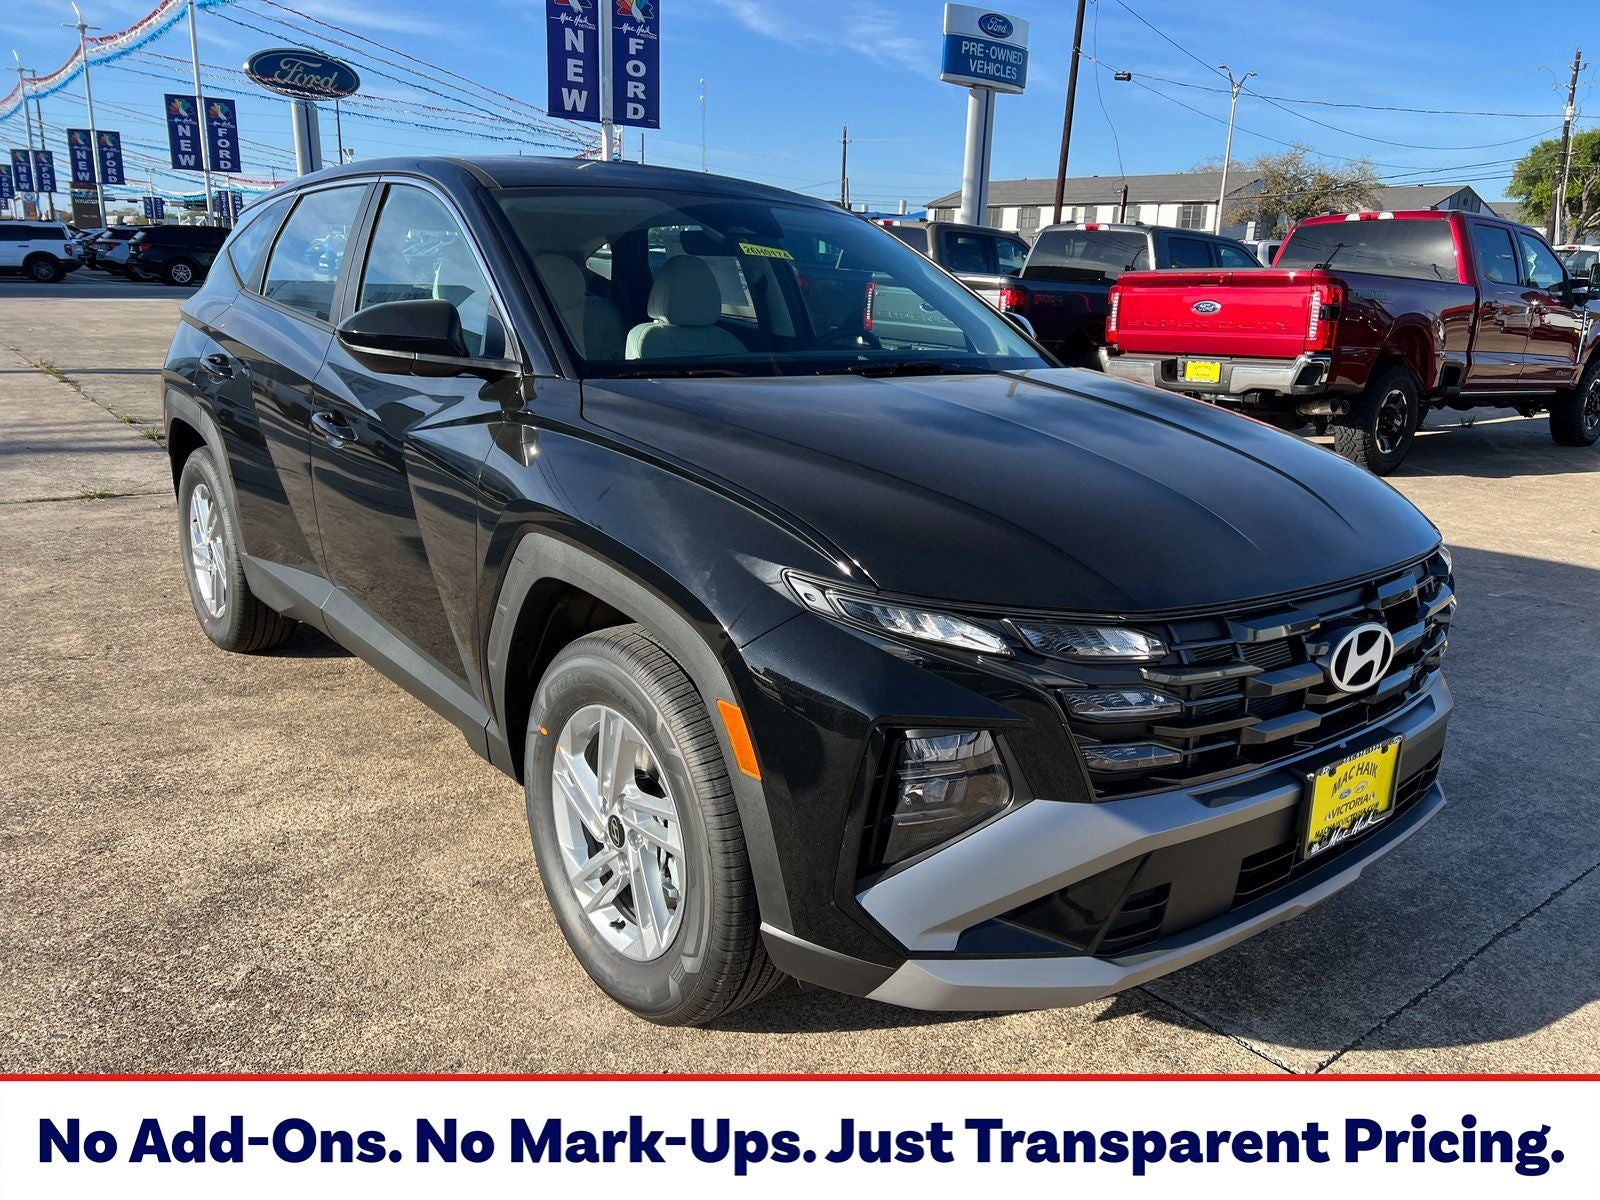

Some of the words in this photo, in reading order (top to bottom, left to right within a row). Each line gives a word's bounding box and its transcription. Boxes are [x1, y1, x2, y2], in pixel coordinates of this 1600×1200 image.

[987, 16, 1008, 33] Ford
[961, 41, 1023, 65] PRE-OWNED
[273, 57, 339, 91] Ford
[562, 27, 588, 113] NEW
[625, 37, 647, 120] FORD
[969, 59, 1017, 80] VEHICLES
[177, 124, 196, 167] NEW
[217, 127, 232, 170] FORD
[18, 165, 30, 190] NEW
[41, 167, 51, 192] FORD
[76, 150, 90, 181] NEW
[106, 152, 118, 183] FORD
[1330, 765, 1356, 798] MAC
[1355, 761, 1379, 778] HAIK
[1331, 793, 1370, 819] VICTORIA
